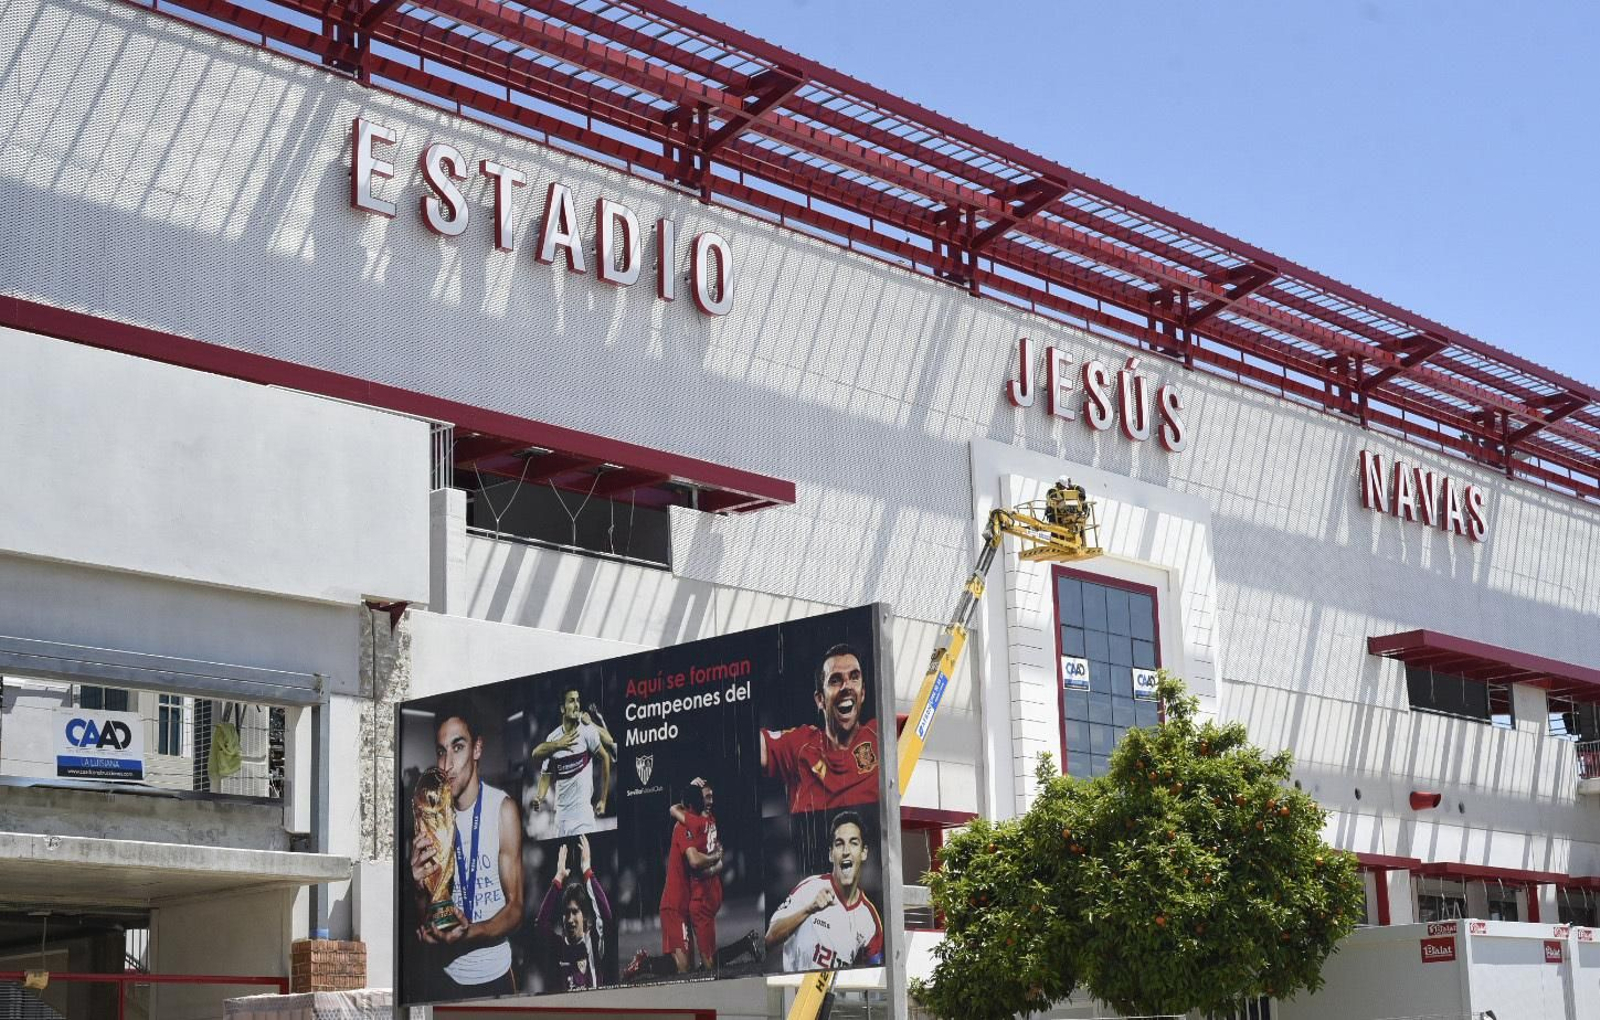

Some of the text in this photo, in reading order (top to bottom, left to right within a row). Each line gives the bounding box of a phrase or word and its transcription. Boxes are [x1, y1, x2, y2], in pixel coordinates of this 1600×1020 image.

[351, 117, 734, 317] ESTADIO
[1006, 337, 1188, 453] JESÚS
[1360, 450, 1489, 543] NAVAS
[625, 659, 751, 699] Aquí se forman
[625, 680, 751, 720] Campeones del
[65, 718, 132, 750] CAAD
[625, 721, 679, 747] Mundo
